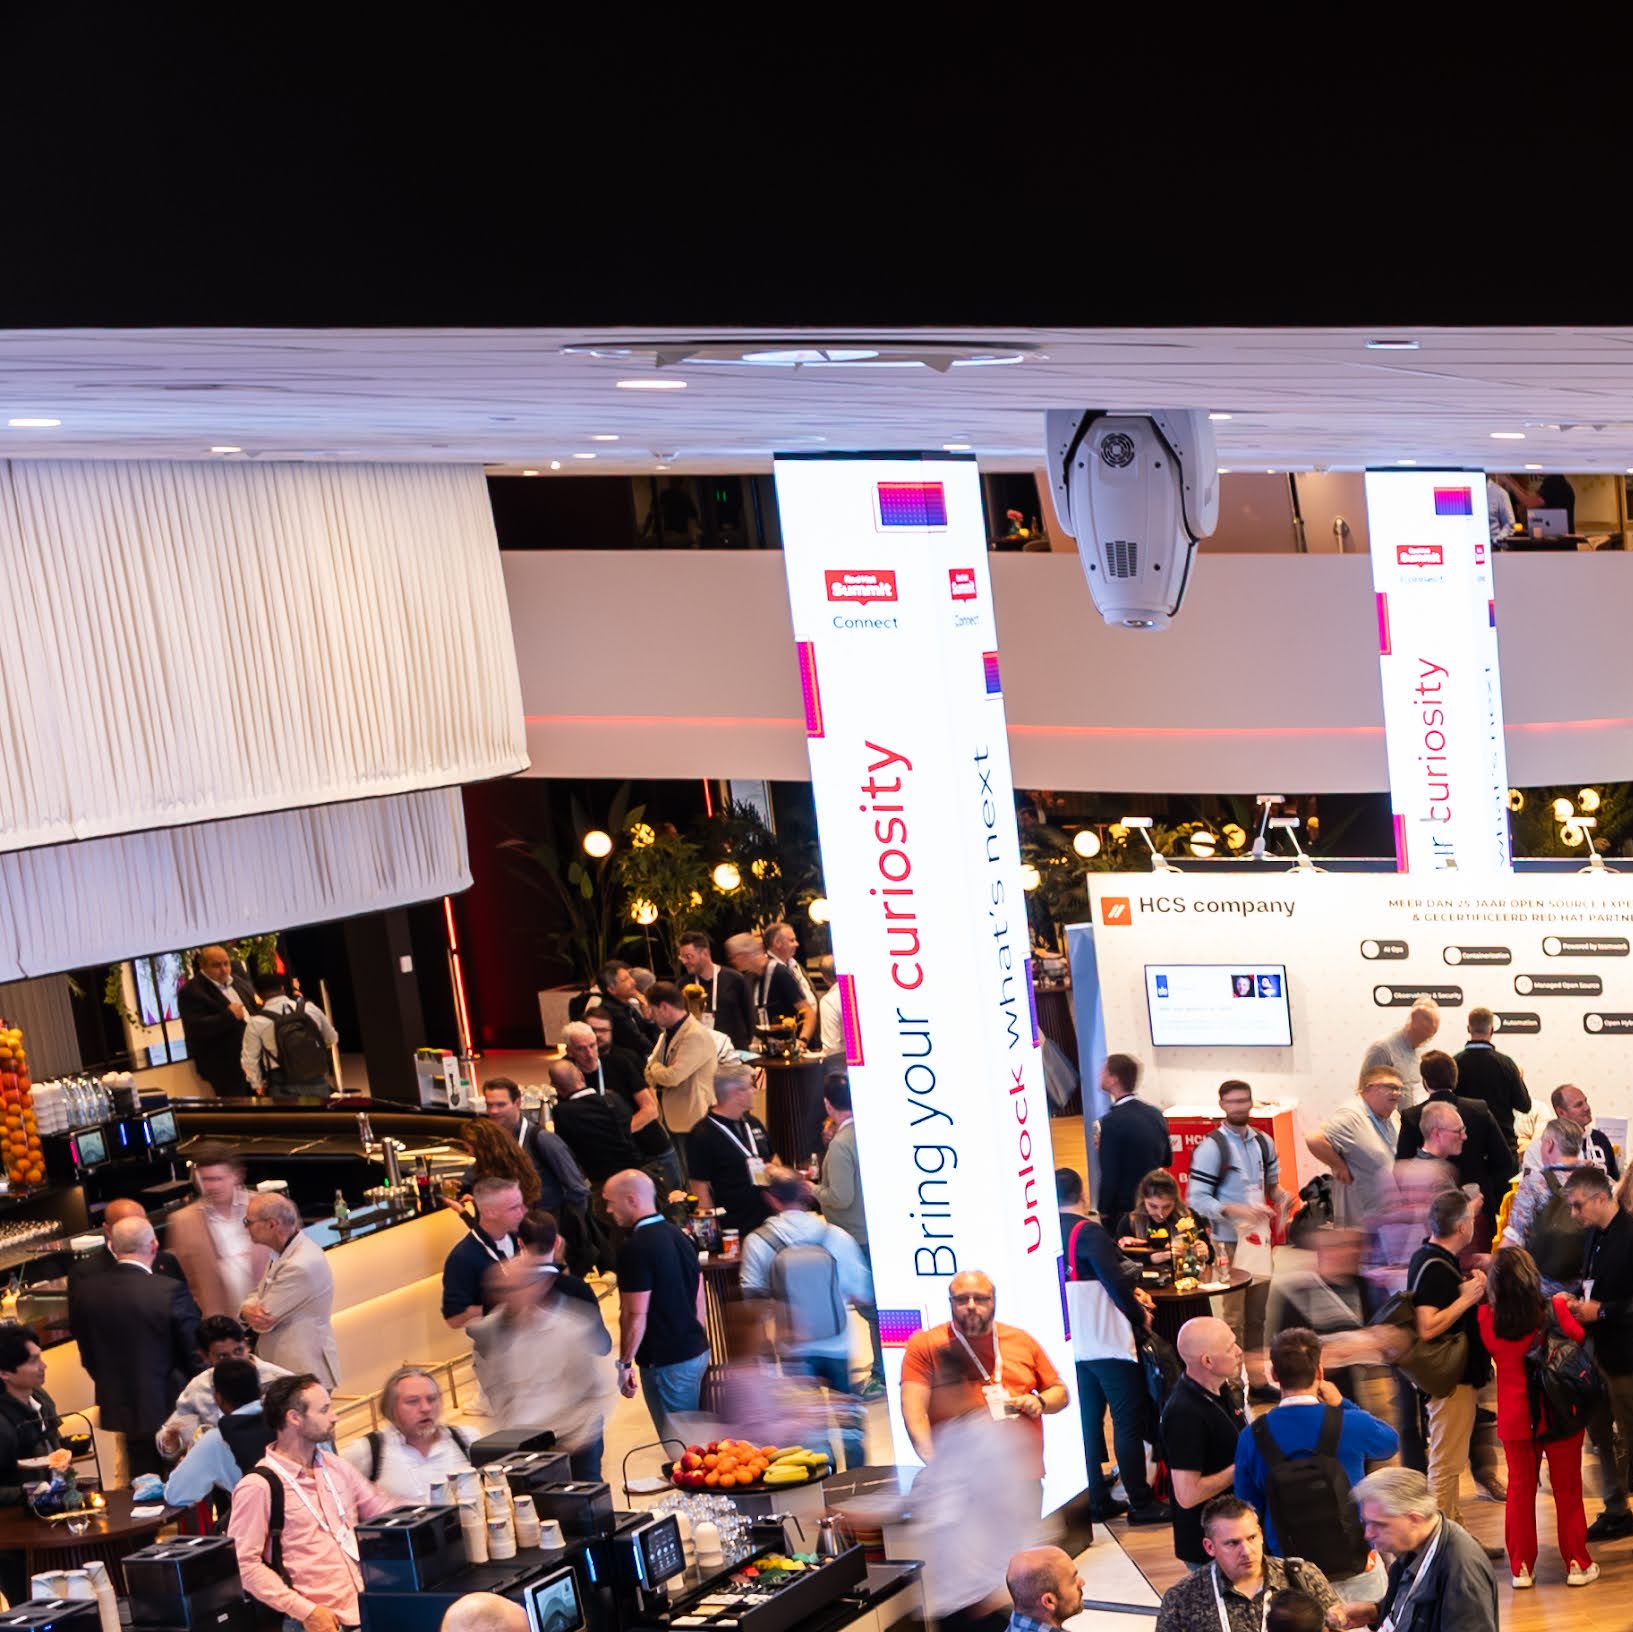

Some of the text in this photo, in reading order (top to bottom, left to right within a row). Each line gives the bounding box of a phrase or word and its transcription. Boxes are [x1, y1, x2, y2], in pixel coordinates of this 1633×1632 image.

[831, 583, 893, 597] Summit
[832, 616, 898, 629] Connect
[1413, 657, 1451, 824] curiosity
[973, 744, 1001, 863] next
[1140, 896, 1296, 918] HCS company
[1388, 899, 1422, 908] MEER
[1426, 899, 1453, 908] DAN
[1458, 899, 1471, 908] 25
[1475, 899, 1508, 909] JAAR
[1510, 899, 1545, 909] OPEN
[1549, 899, 1596, 909] SOURCE
[1412, 913, 1420, 922] &
[1424, 913, 1528, 922] GECERTIFICEERD
[1531, 913, 1557, 922] RED
[1560, 913, 1585, 922] HAT
[1562, 942, 1588, 951] Powered
[988, 879, 1020, 1050] what's
[1533, 981, 1600, 990] Managed Open Source
[1438, 991, 1462, 1001] Security
[859, 740, 958, 1277] Bring your curiosity
[1502, 1018, 1538, 1027] Automation
[1604, 1018, 1620, 1027] Open
